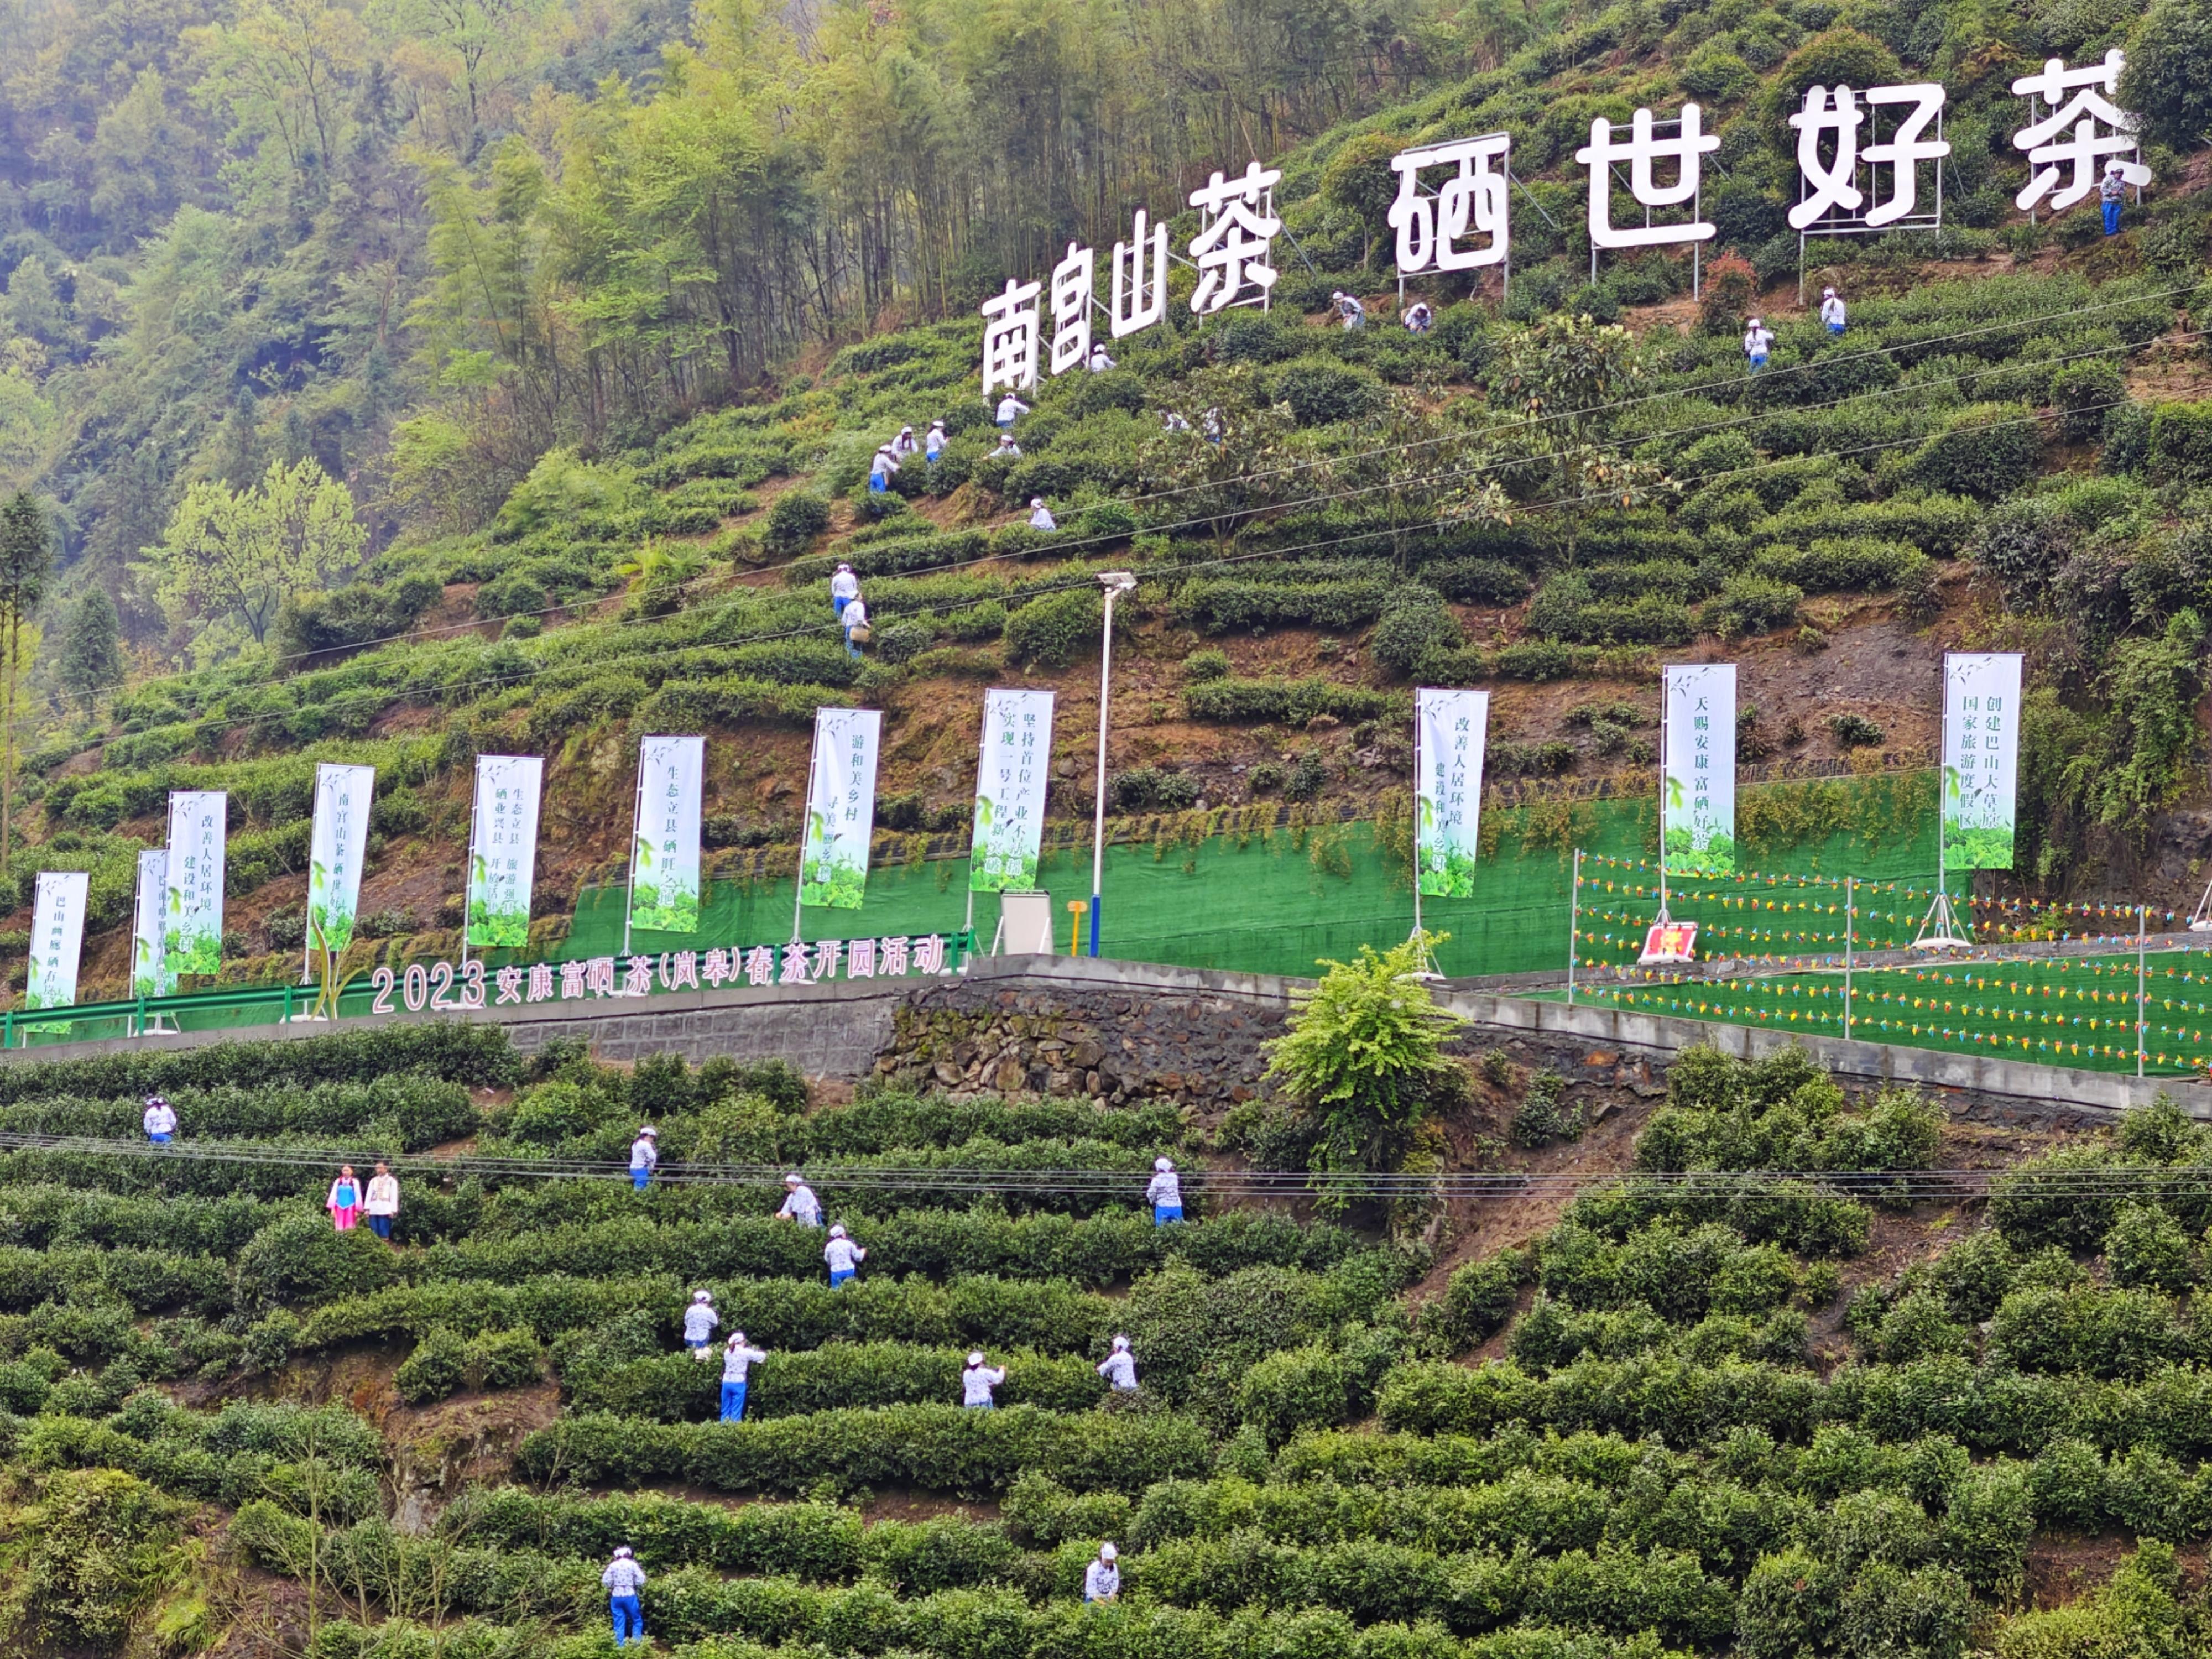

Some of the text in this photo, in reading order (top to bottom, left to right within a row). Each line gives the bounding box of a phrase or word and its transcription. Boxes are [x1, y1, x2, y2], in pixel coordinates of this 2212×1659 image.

[982, 49, 2152, 399] 南宫山茶 硒世好茶
[844, 735, 864, 821] 游和美乡村
[1432, 763, 1446, 871] 建设和美乡村
[1449, 717, 1469, 825] 改善人居环境
[1692, 697, 1709, 850] 天赐安康富硒好茶
[1959, 696, 1978, 828] 国家旅游度假区
[1980, 696, 2002, 829] 创建巴山大草原
[200, 815, 213, 911] 改善人居环境
[660, 766, 679, 905] 生态立县硒旺之地
[180, 856, 196, 952] 建设和美乡村
